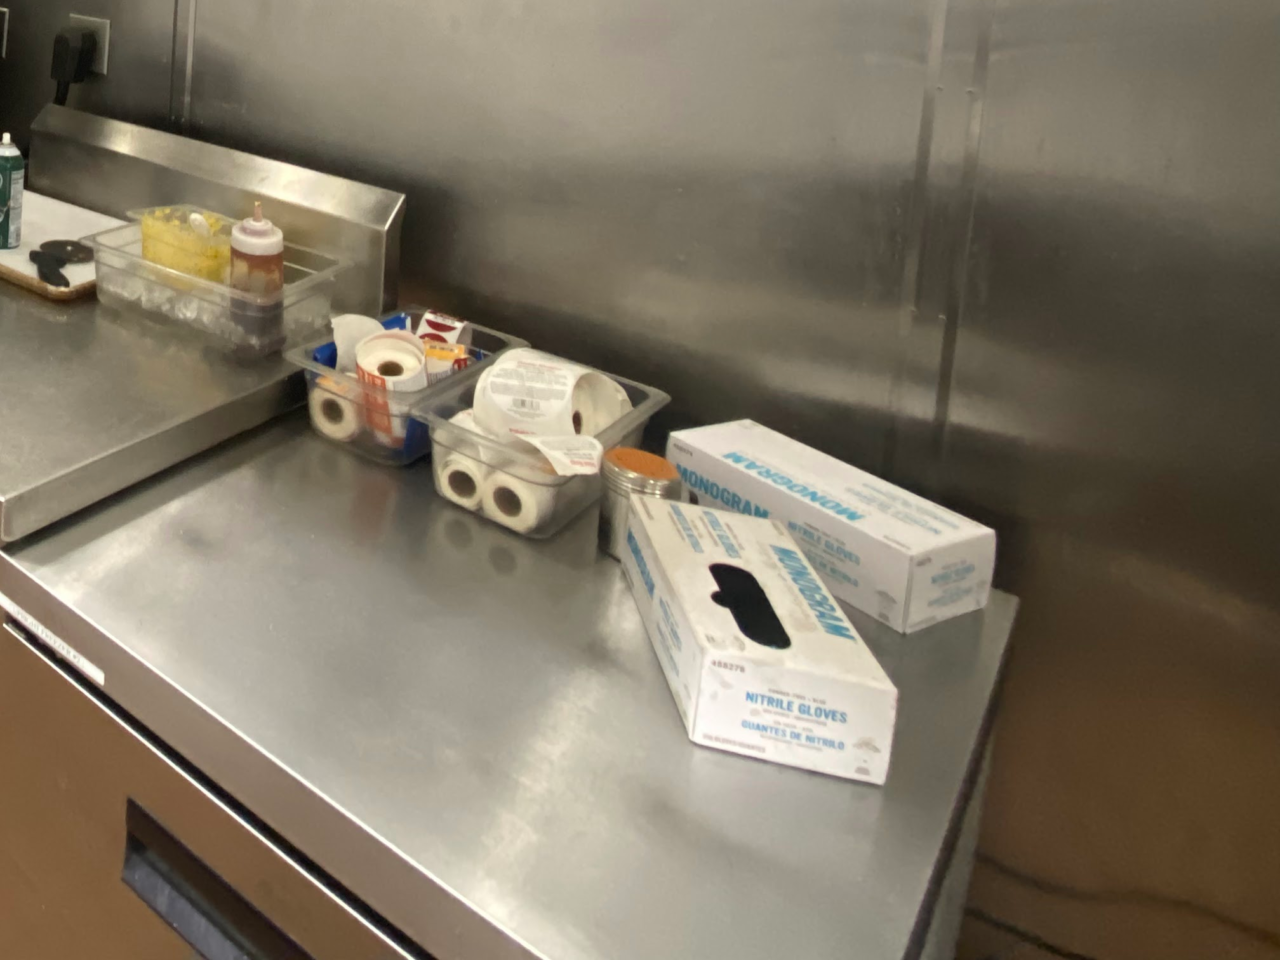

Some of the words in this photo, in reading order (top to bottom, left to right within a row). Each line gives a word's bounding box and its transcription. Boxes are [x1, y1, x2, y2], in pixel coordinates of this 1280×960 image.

[675, 463, 770, 520] MONOGRAM
[722, 451, 866, 522] MONOGRAM
[769, 544, 857, 642] MONOGRAM
[741, 719, 787, 738] GUANTES
[789, 730, 802, 741] DE
[805, 734, 845, 751] NITRILO
[745, 690, 795, 713] NITRILE
[797, 702, 848, 724] GLOVES
